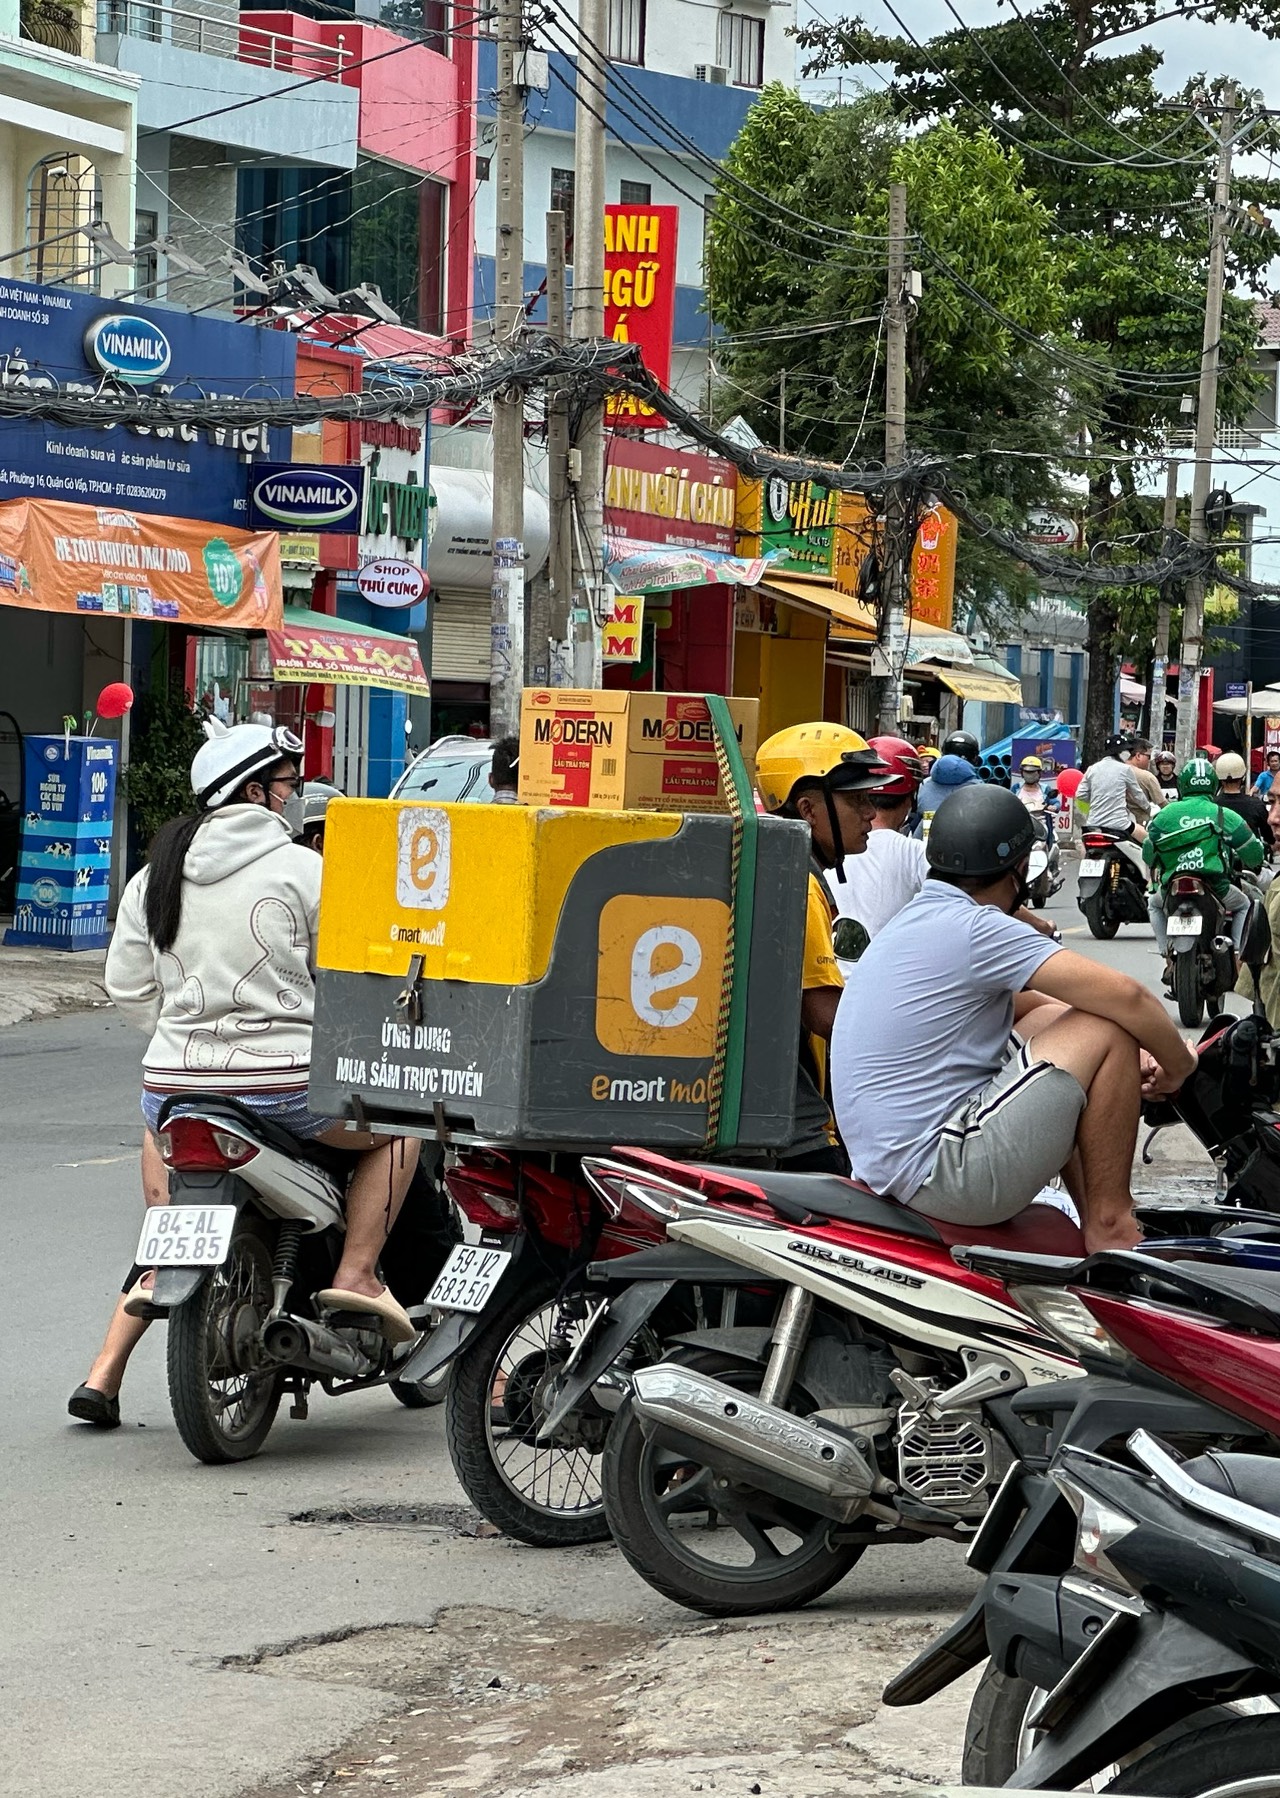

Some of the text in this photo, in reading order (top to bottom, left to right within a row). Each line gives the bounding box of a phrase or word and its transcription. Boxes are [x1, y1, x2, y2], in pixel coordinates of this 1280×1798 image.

[23, 293, 39, 304] NAM
[7, 308, 32, 322] DOANH
[41, 313, 50, 325] 38
[102, 331, 165, 362] VINAMILK
[46, 441, 64, 455] Kinh
[65, 444, 89, 459] doanh
[36, 475, 45, 490] 16,
[604, 465, 642, 512] ANH
[265, 485, 349, 506] VINAMILK
[373, 565, 410, 576] SHOP
[360, 577, 418, 597] THÚ CƯNG
[534, 718, 613, 746] MODERN
[1190, 777, 1211, 786] Grab
[410, 826, 439, 891] e
[1178, 847, 1205, 864] Grab
[631, 925, 702, 1028] e
[336, 1052, 484, 1099] MUA SẮM TRỰC TUYẾN
[591, 1074, 667, 1103] emart
[157, 1211, 219, 1235] 84-AL
[145, 1236, 221, 1261] 025.85
[450, 1248, 501, 1279] 59-V2
[788, 1240, 927, 1289] AIR BLADE
[430, 1276, 491, 1308] 683.50
